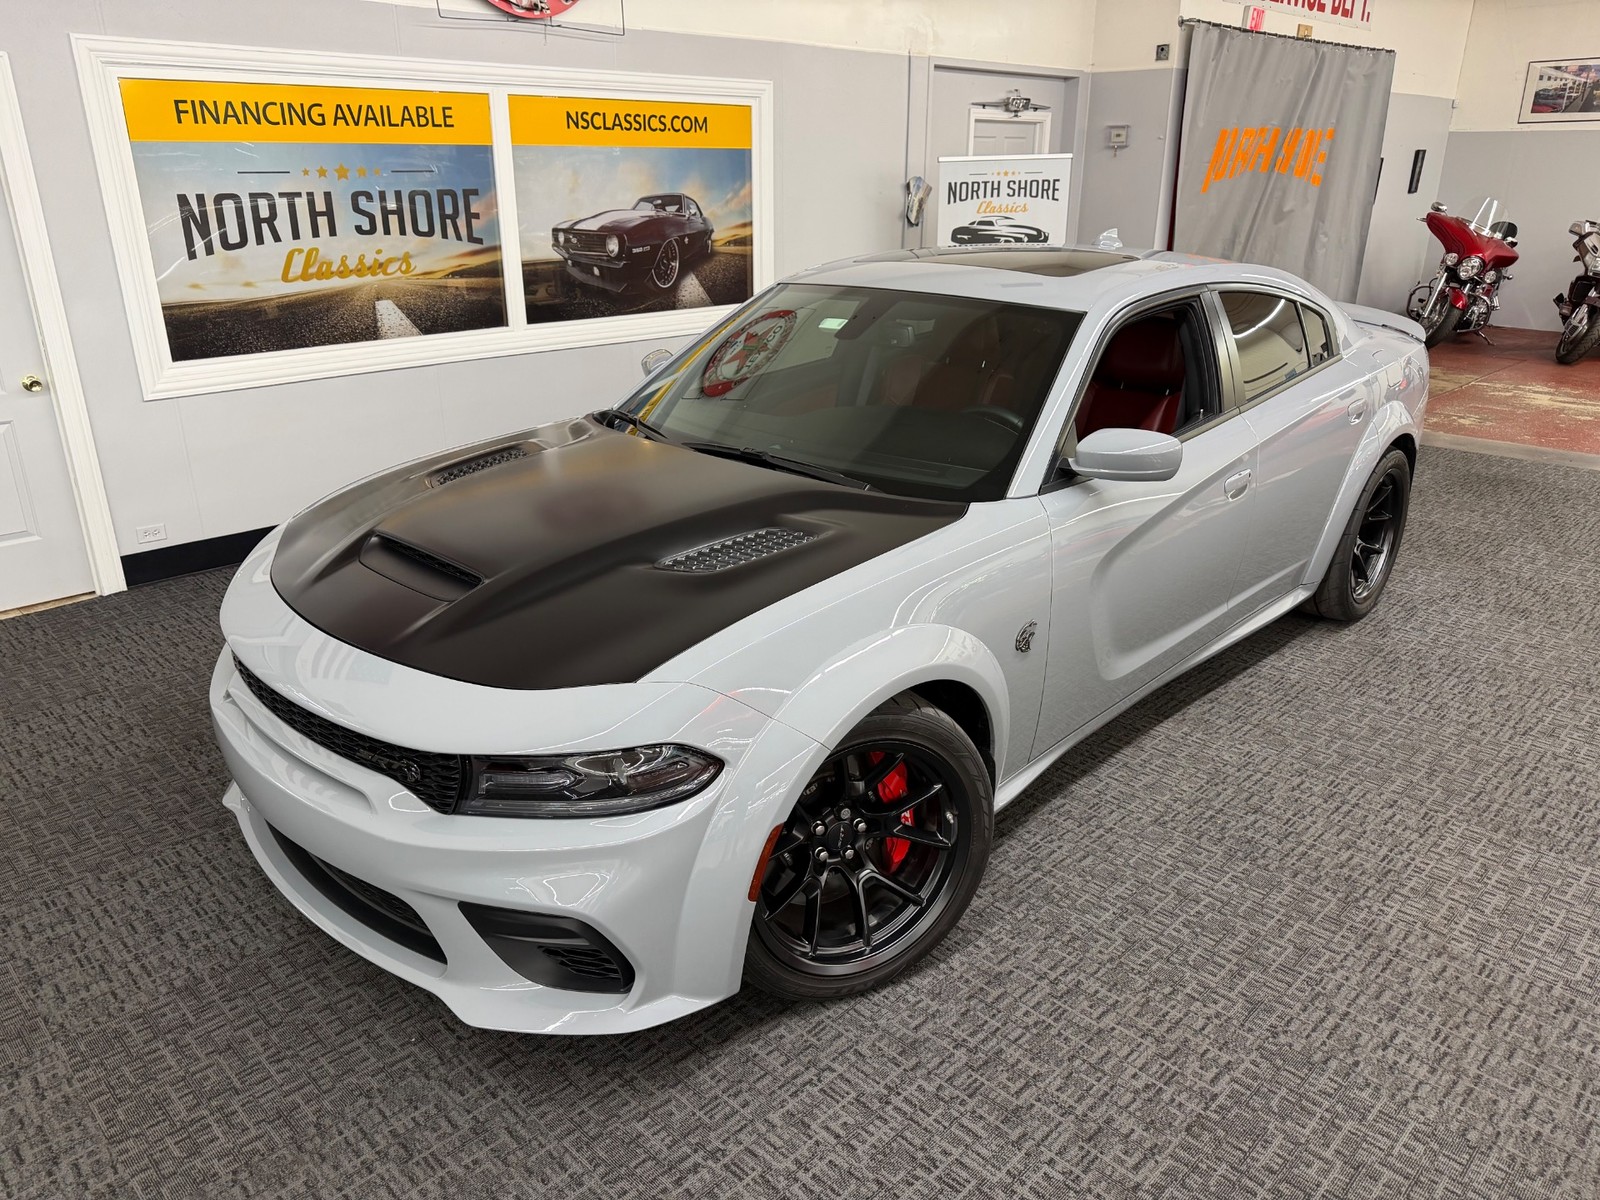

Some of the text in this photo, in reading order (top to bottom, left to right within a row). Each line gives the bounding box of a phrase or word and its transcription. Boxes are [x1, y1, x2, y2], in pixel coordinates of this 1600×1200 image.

[173, 99, 455, 128] FINANCING AVAILABLE
[566, 110, 708, 134] NSCLASSICS.COM
[947, 178, 1060, 205] NORTH SHORE
[976, 200, 1029, 214] Classics
[177, 188, 484, 261] NORTH SHORE
[280, 247, 417, 284] Classics
